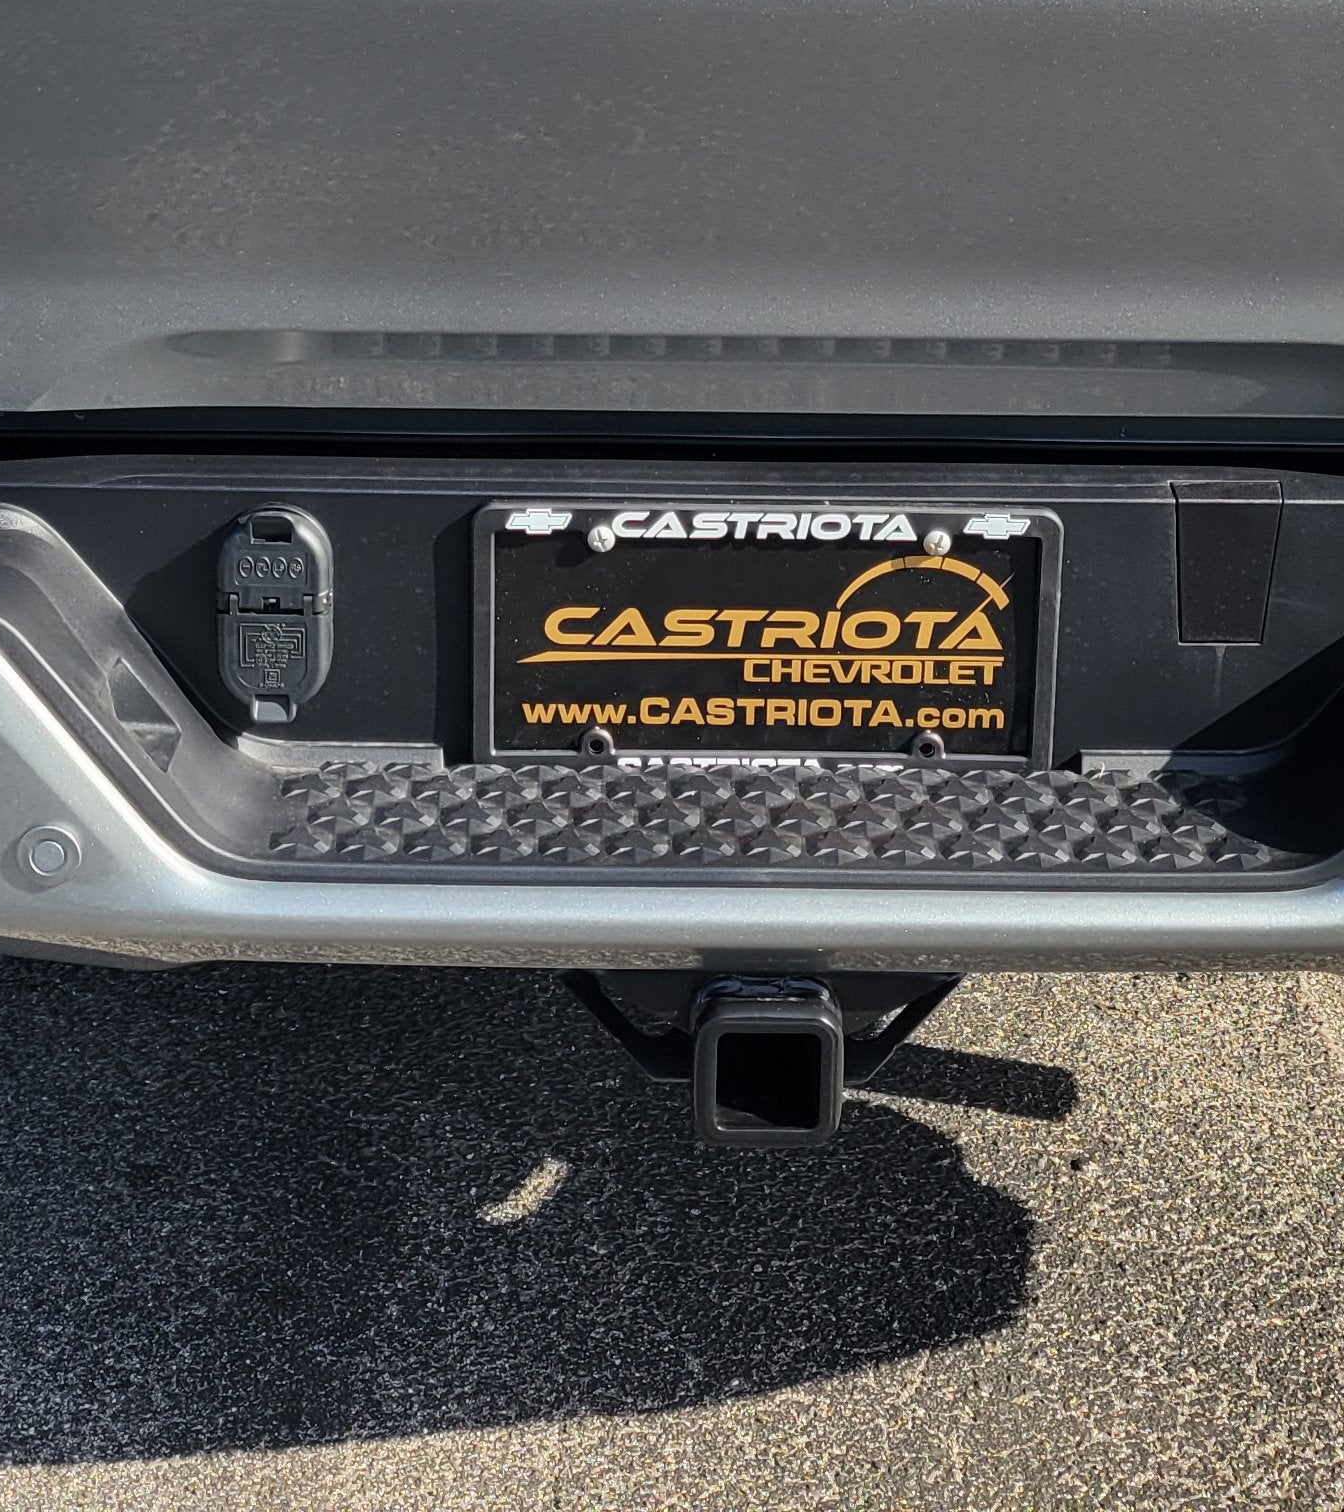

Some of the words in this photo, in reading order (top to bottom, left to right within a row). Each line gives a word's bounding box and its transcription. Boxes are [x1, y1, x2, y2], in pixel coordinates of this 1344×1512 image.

[611, 510, 917, 542] CASTRIOTA
[544, 606, 1003, 650] CASTRIOTA
[742, 660, 997, 686] CHEVROLET
[521, 696, 1006, 730] www.CASTRIOTA.com
